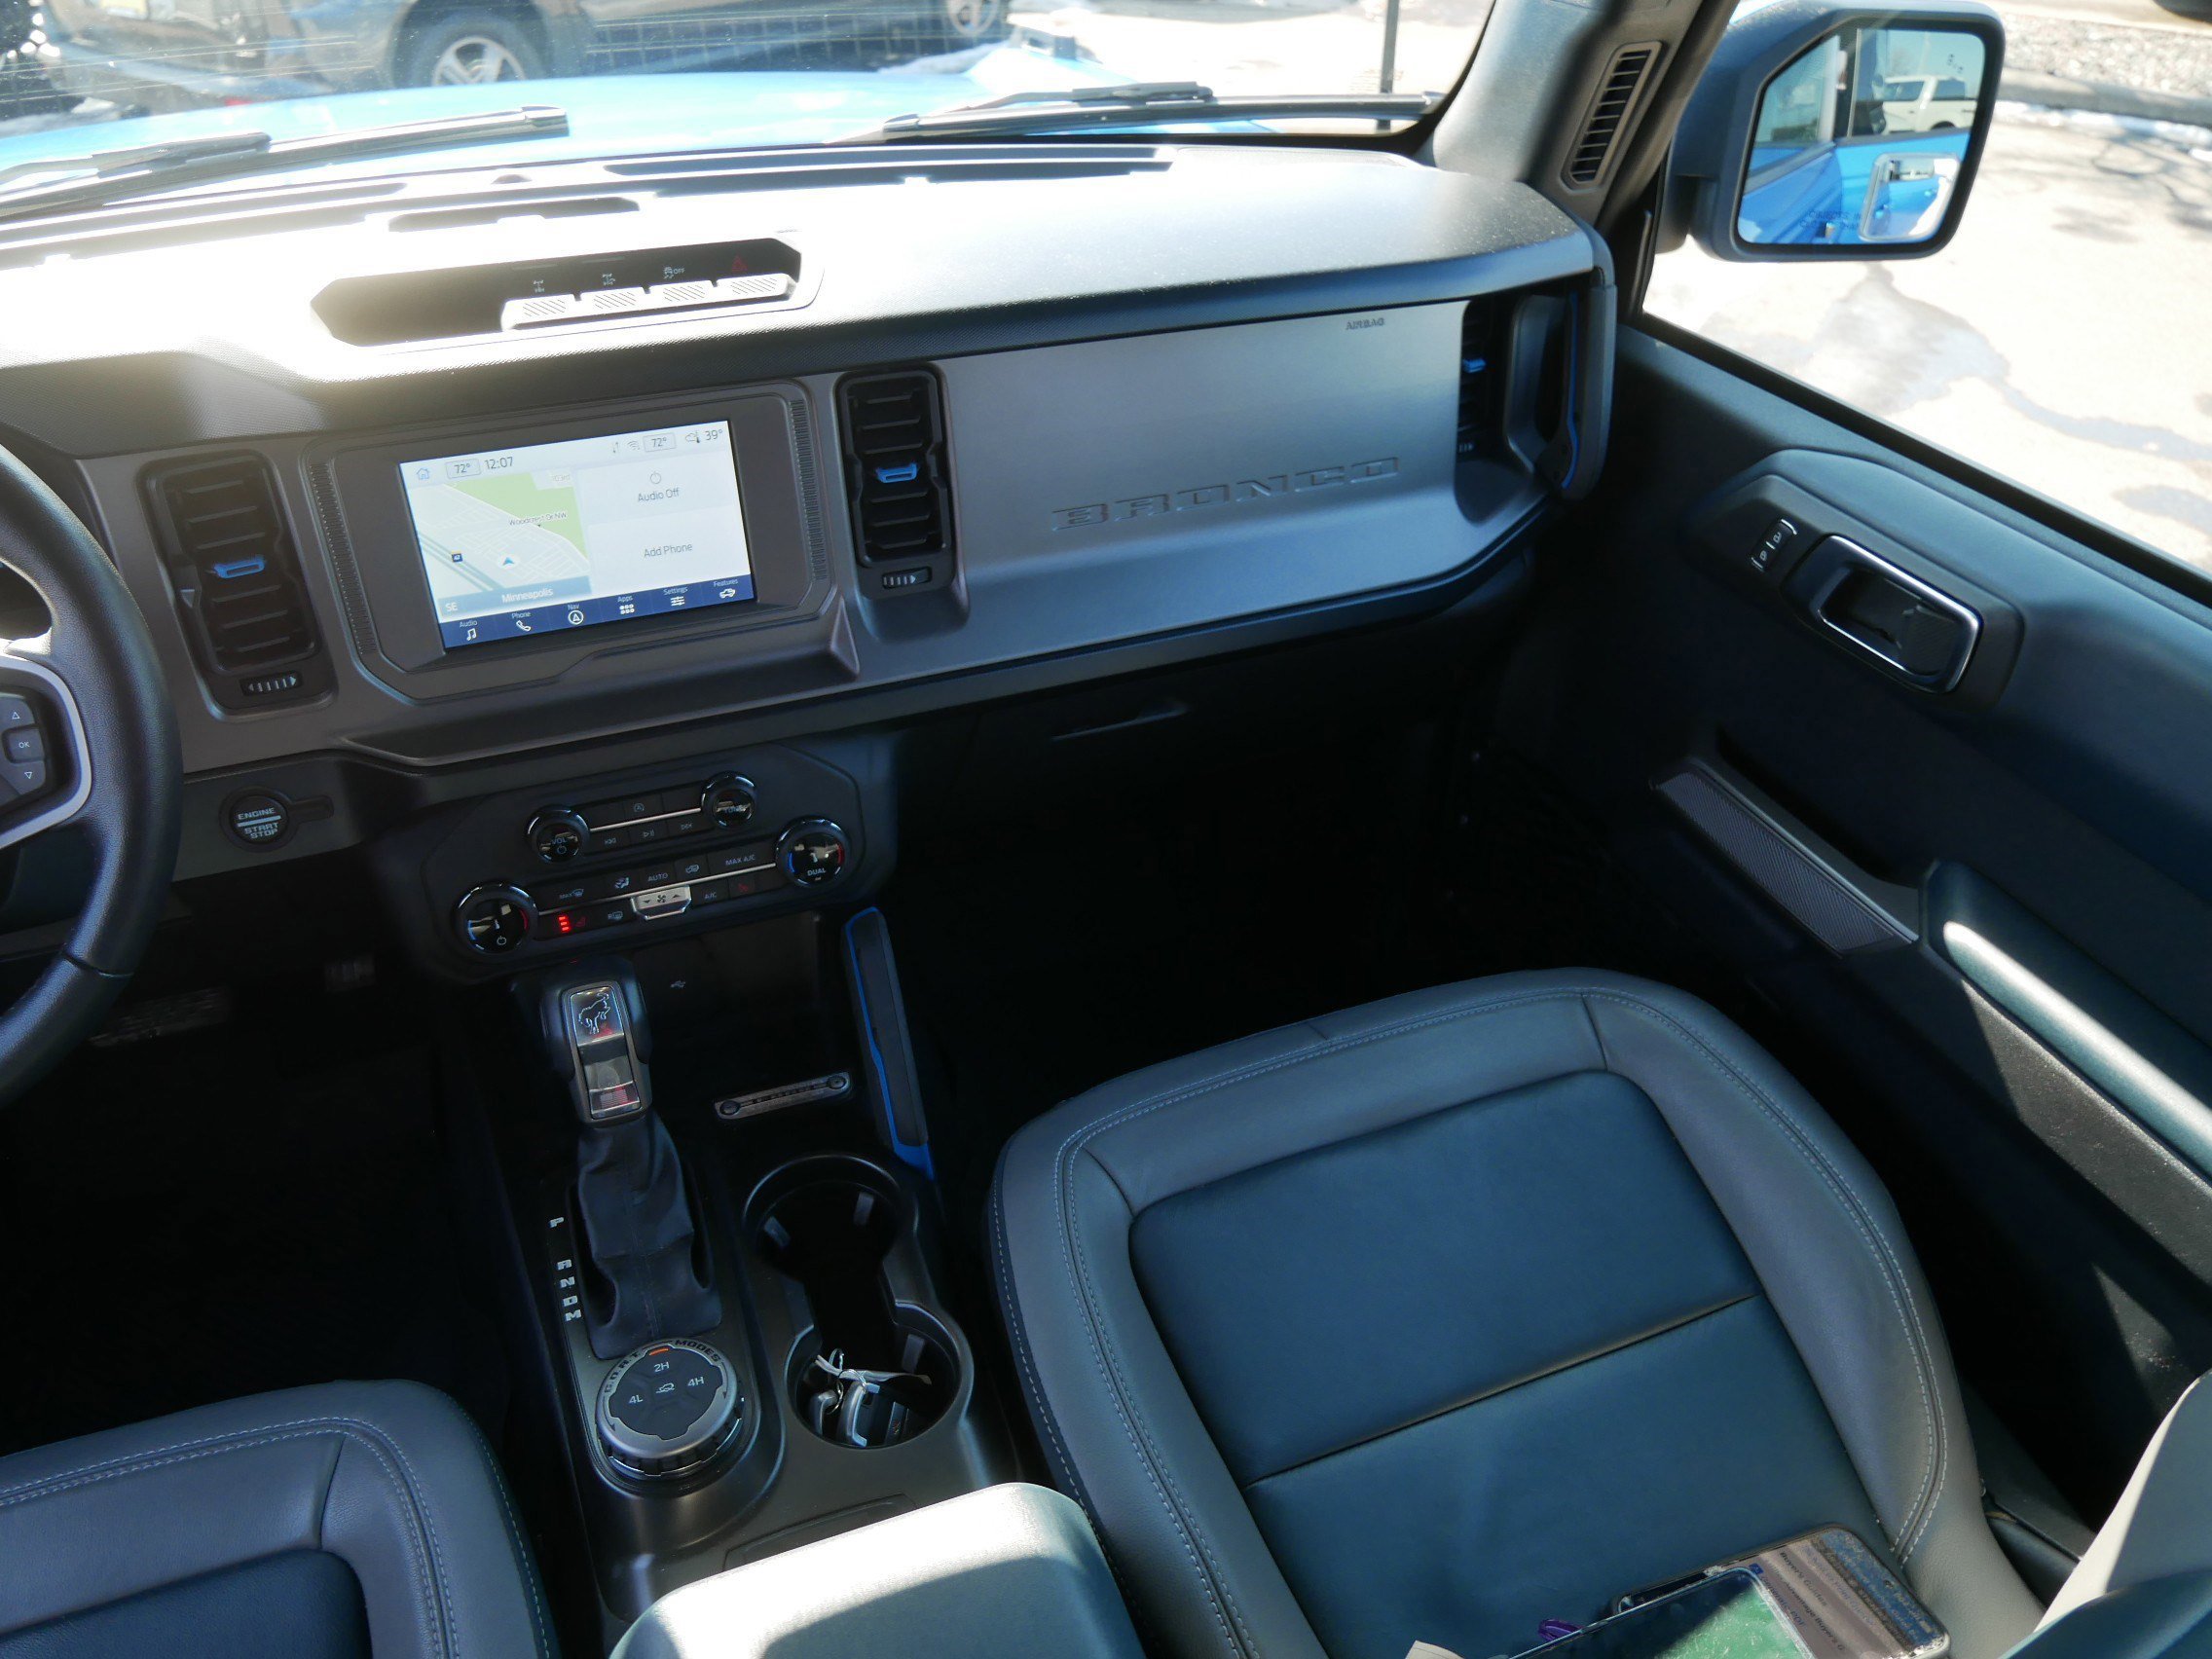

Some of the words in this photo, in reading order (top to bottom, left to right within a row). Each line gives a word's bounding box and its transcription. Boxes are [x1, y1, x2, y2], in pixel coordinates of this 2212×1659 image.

[705, 428, 724, 442] 39°
[651, 436, 668, 449] 72°
[454, 461, 472, 475] 72°
[485, 456, 514, 471] 12:07
[638, 490, 664, 502] Audio
[665, 486, 681, 498] Off
[1051, 457, 1400, 533] BRONCO
[643, 546, 665, 559] Add
[667, 541, 693, 557] Phone
[713, 577, 739, 588] Features
[501, 587, 554, 604] Minneapolis
[663, 585, 689, 596] Settings
[617, 594, 634, 604] Apps
[445, 602, 459, 612] SE
[567, 603, 580, 611] Nav
[511, 610, 532, 620] Phone
[459, 619, 478, 629] Audio
[238, 807, 276, 820] ENGINE
[244, 823, 279, 834] START
[250, 829, 278, 839] STOP
[725, 857, 742, 866] MAX
[647, 872, 669, 882] AUTO
[806, 867, 827, 876] DUAL
[549, 1216, 565, 1228] P
[560, 1275, 575, 1288] N
[563, 1295, 578, 1307] D
[565, 1309, 582, 1322] M
[675, 1338, 721, 1363] MODES
[653, 1361, 670, 1373] 2H
[687, 1376, 705, 1387] 4H
[628, 1394, 644, 1405] 4L
